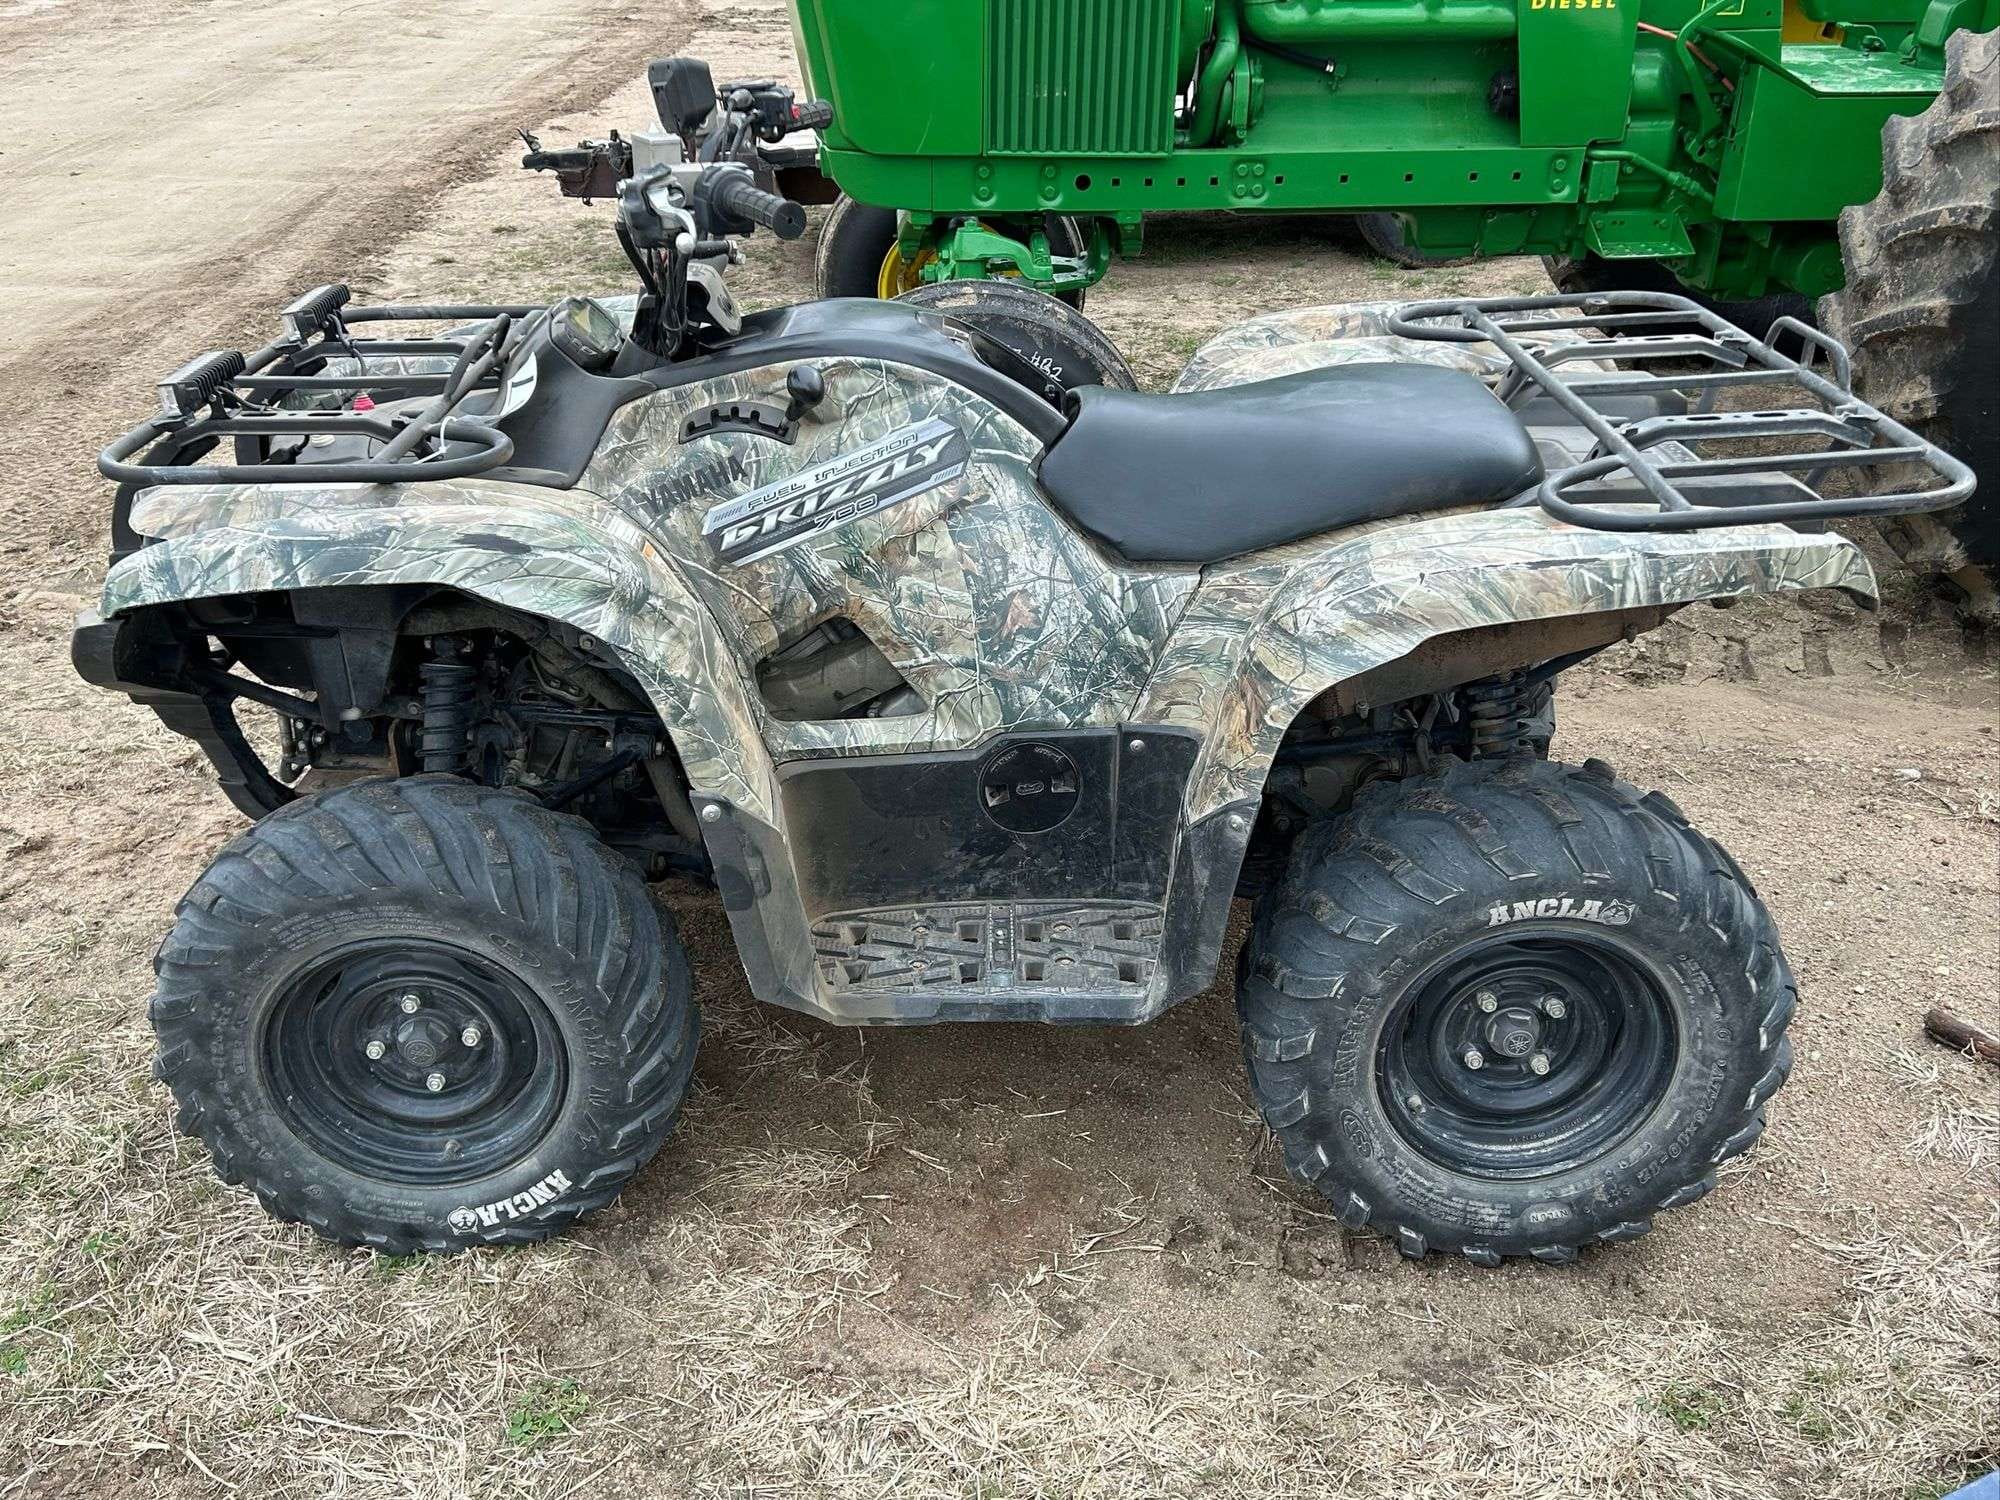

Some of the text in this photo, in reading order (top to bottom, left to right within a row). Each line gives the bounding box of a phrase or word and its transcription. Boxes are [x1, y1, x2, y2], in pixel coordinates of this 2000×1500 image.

[638, 455, 749, 515] YAMAHA
[719, 433, 957, 551] GRIZZLY
[747, 432, 918, 511] FUEL INJECTION
[813, 494, 879, 532] 700
[1486, 898, 1603, 928] ANCLA
[474, 1168, 573, 1227] ANCLA
